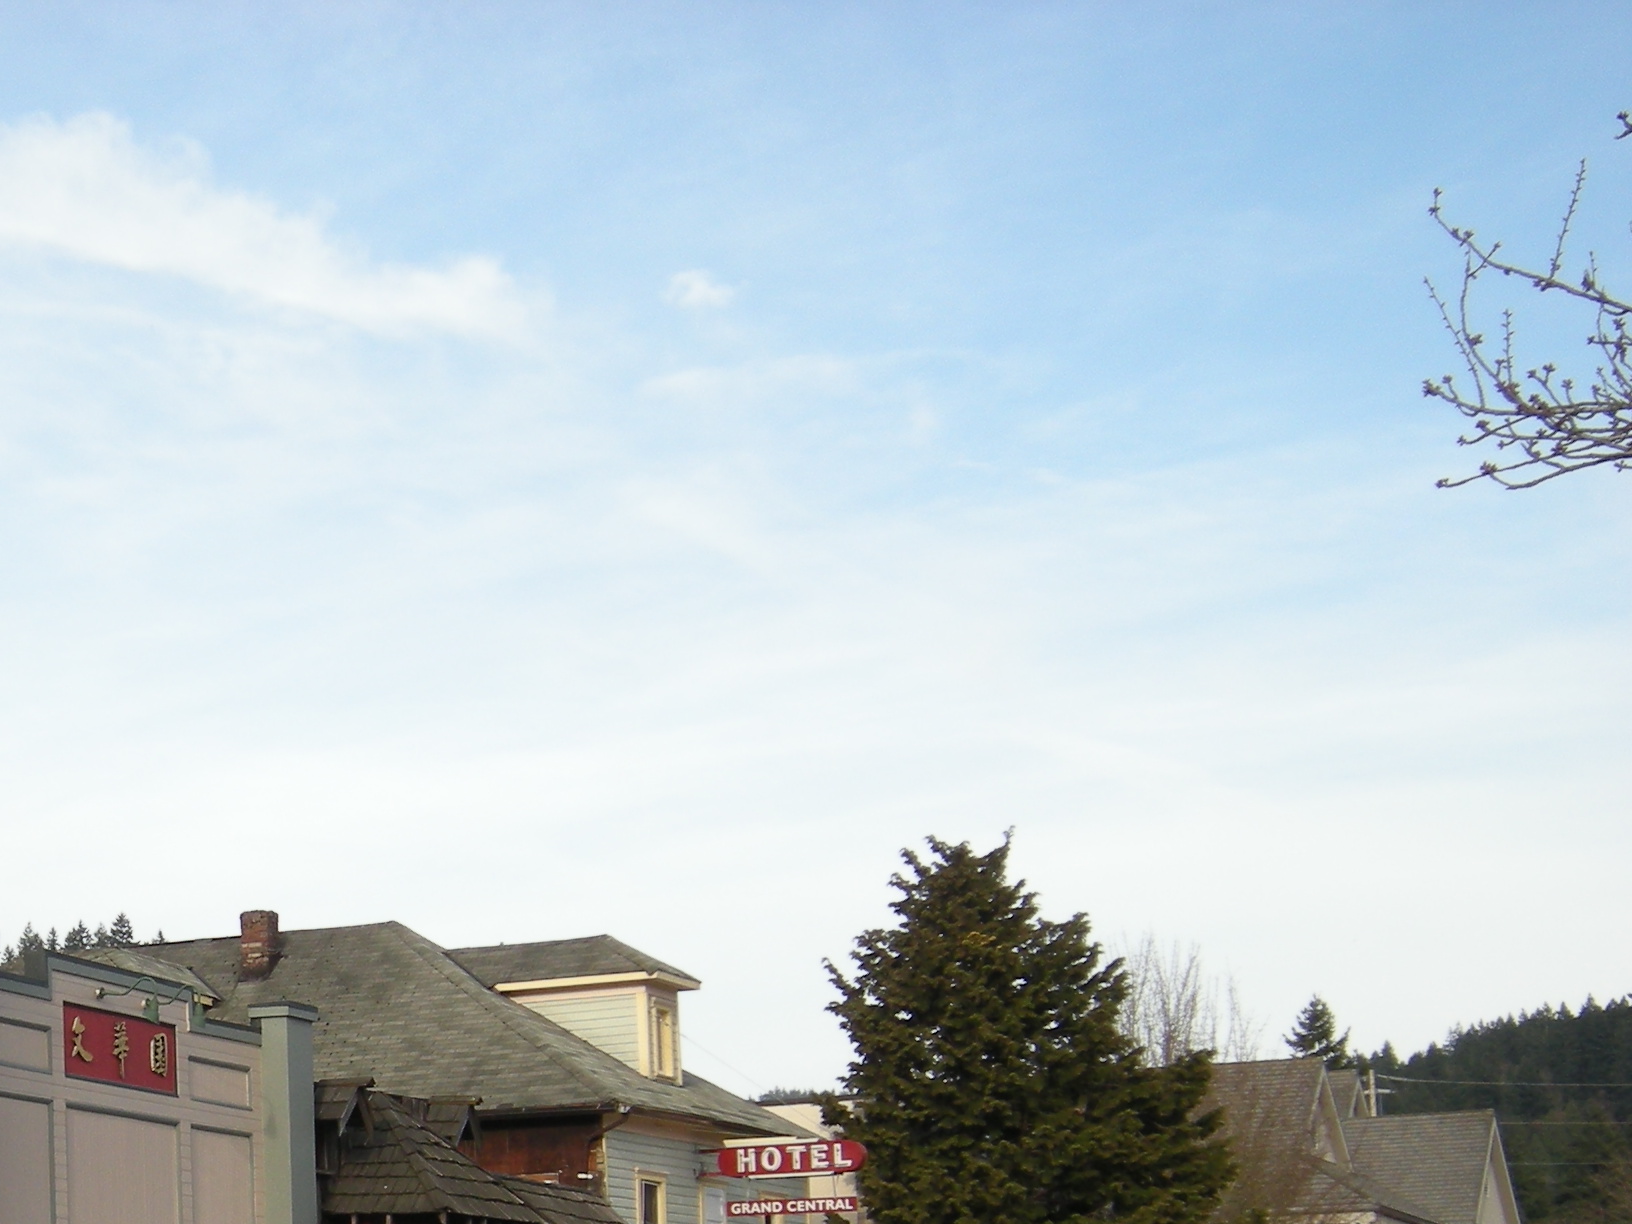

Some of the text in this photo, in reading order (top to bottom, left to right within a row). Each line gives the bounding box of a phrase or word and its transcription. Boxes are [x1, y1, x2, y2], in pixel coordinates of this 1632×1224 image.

[736, 1142, 853, 1174] HOTEL
[730, 1198, 854, 1216] GRAND CENTRAL
